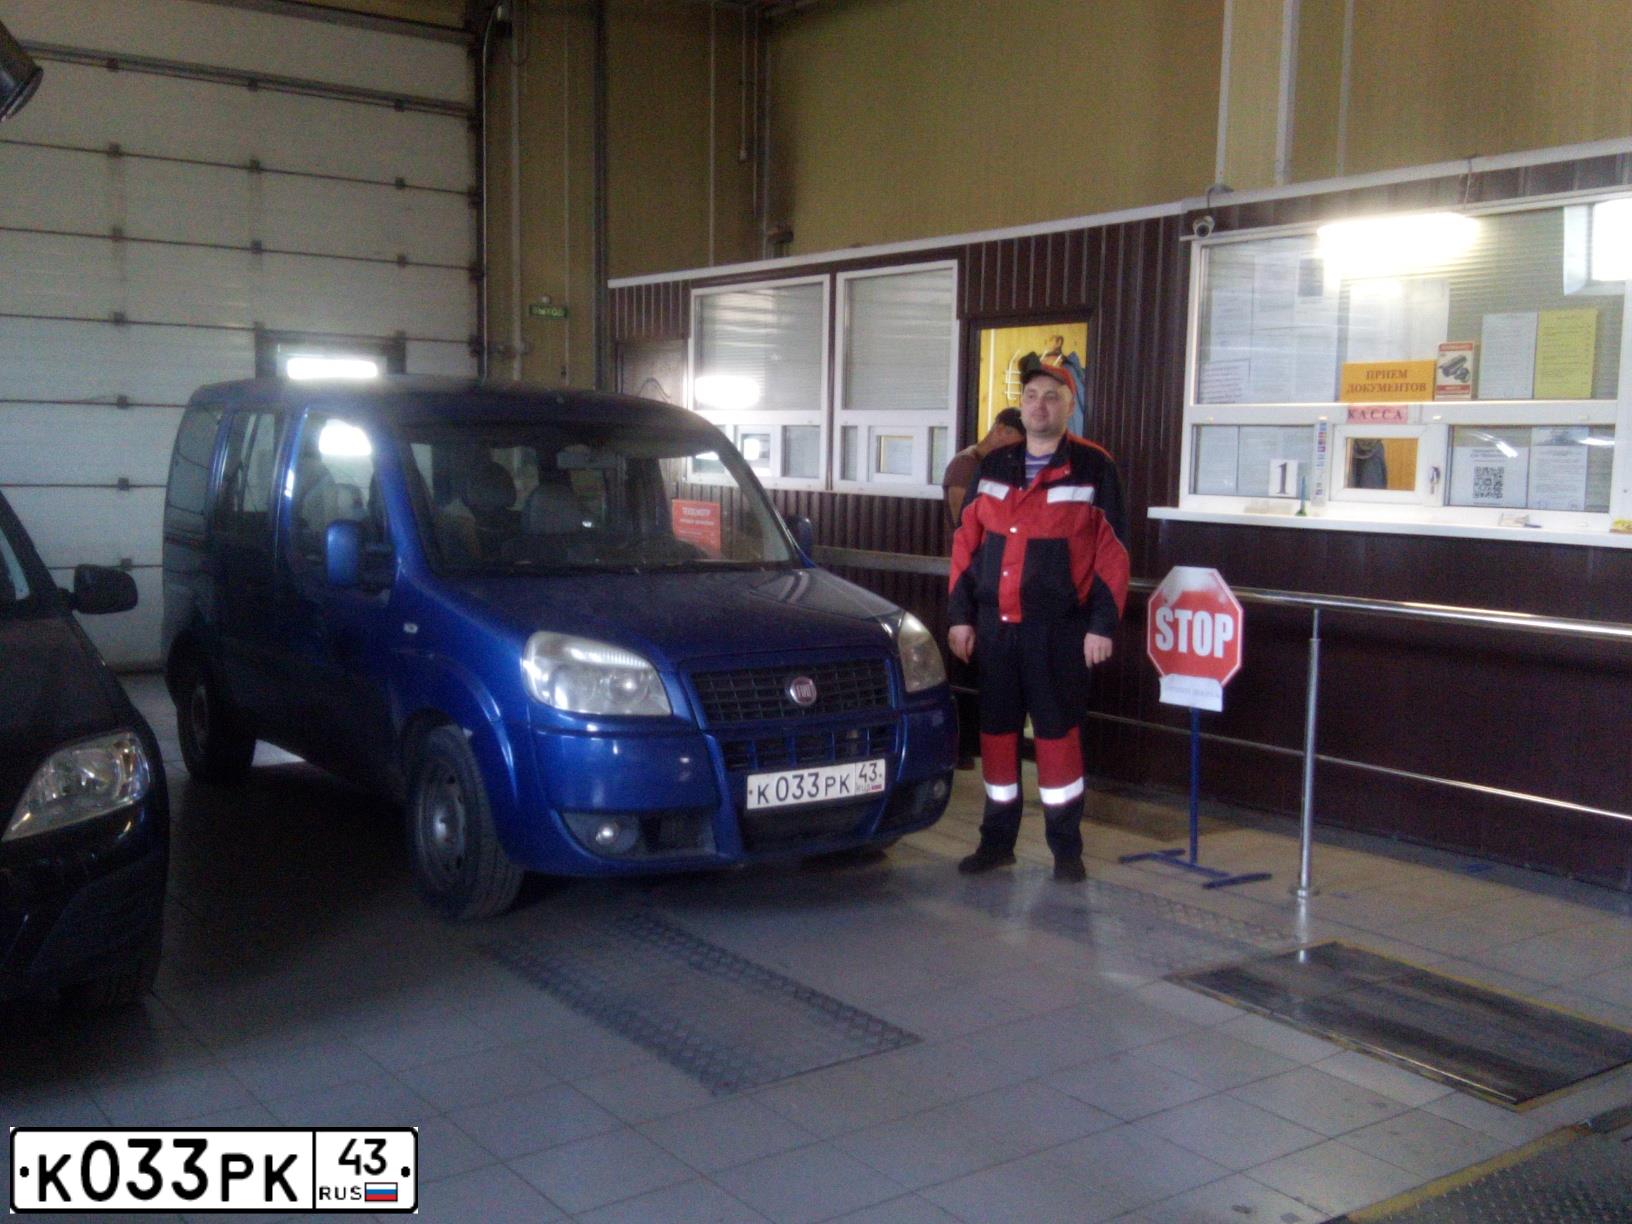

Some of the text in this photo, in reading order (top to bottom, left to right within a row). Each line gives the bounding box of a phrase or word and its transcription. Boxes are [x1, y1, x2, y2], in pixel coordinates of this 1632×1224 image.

[1365, 369, 1408, 380] ПРИЕМ
[1346, 382, 1427, 394] ДОКУМЕНТОВ
[1347, 408, 1403, 420] КАССА
[1275, 462, 1289, 495] 1
[1155, 605, 1234, 659] STOP
[858, 762, 878, 784] 43
